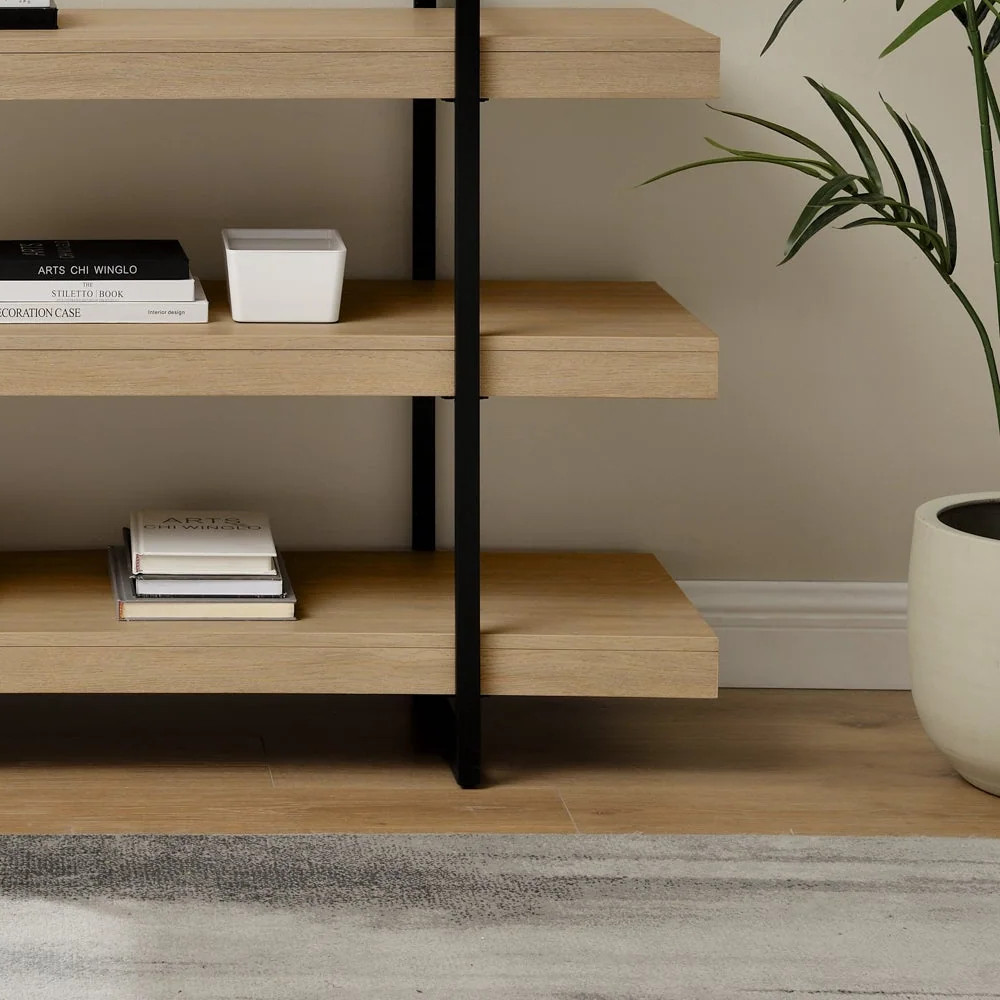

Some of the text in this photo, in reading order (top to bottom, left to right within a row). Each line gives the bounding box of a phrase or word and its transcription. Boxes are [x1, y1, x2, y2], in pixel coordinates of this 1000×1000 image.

[38, 265, 138, 275] ARTS CHI WINGLO
[51, 290, 124, 298] STILETTO BOOK
[54, 308, 82, 318] CASE
